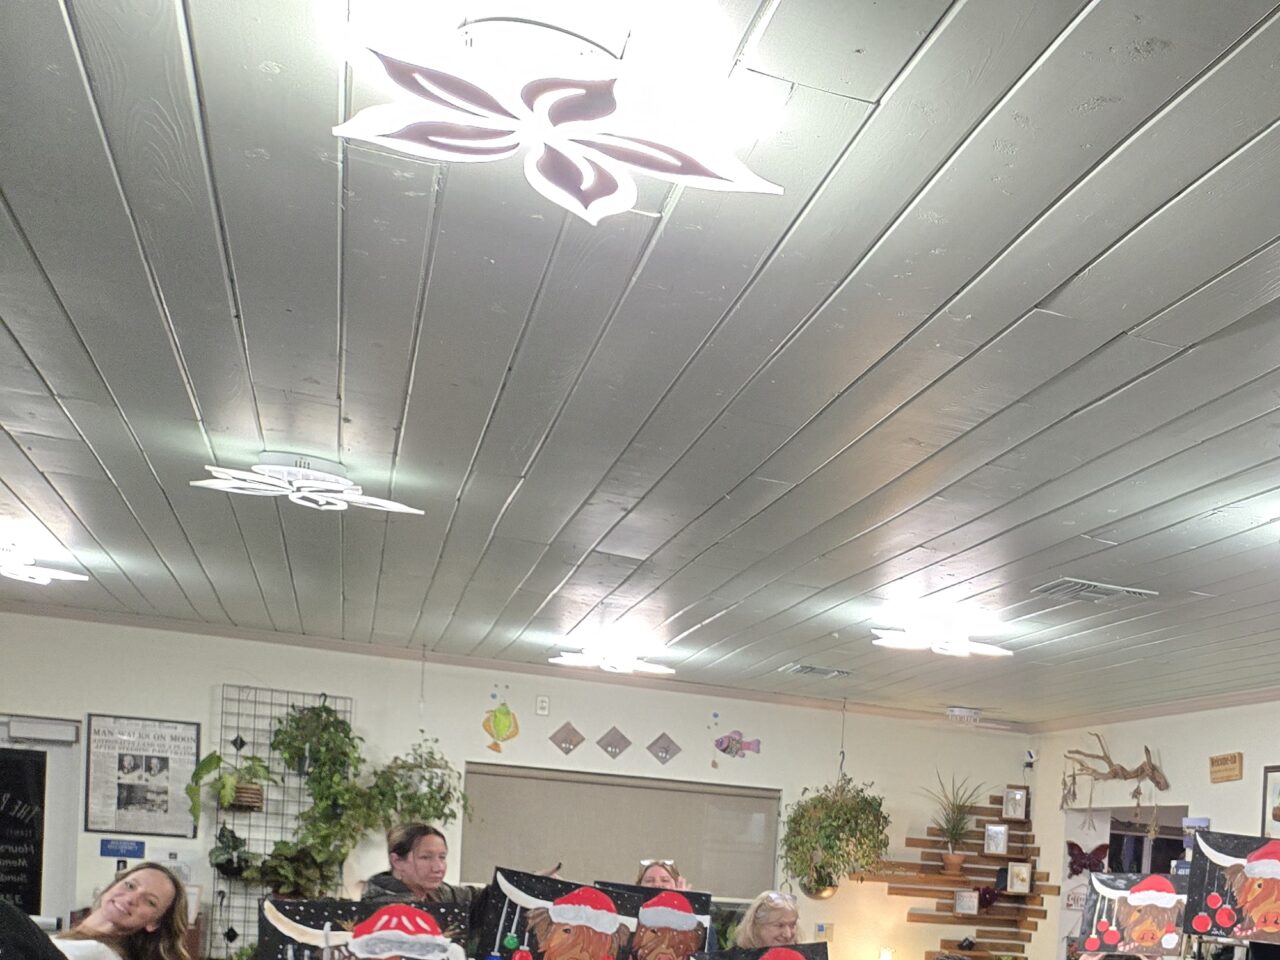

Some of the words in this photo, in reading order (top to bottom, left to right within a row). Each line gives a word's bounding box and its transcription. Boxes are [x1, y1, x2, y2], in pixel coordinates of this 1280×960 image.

[93, 728, 114, 737] MAN
[153, 733, 166, 741] ON
[170, 734, 196, 744] MOON
